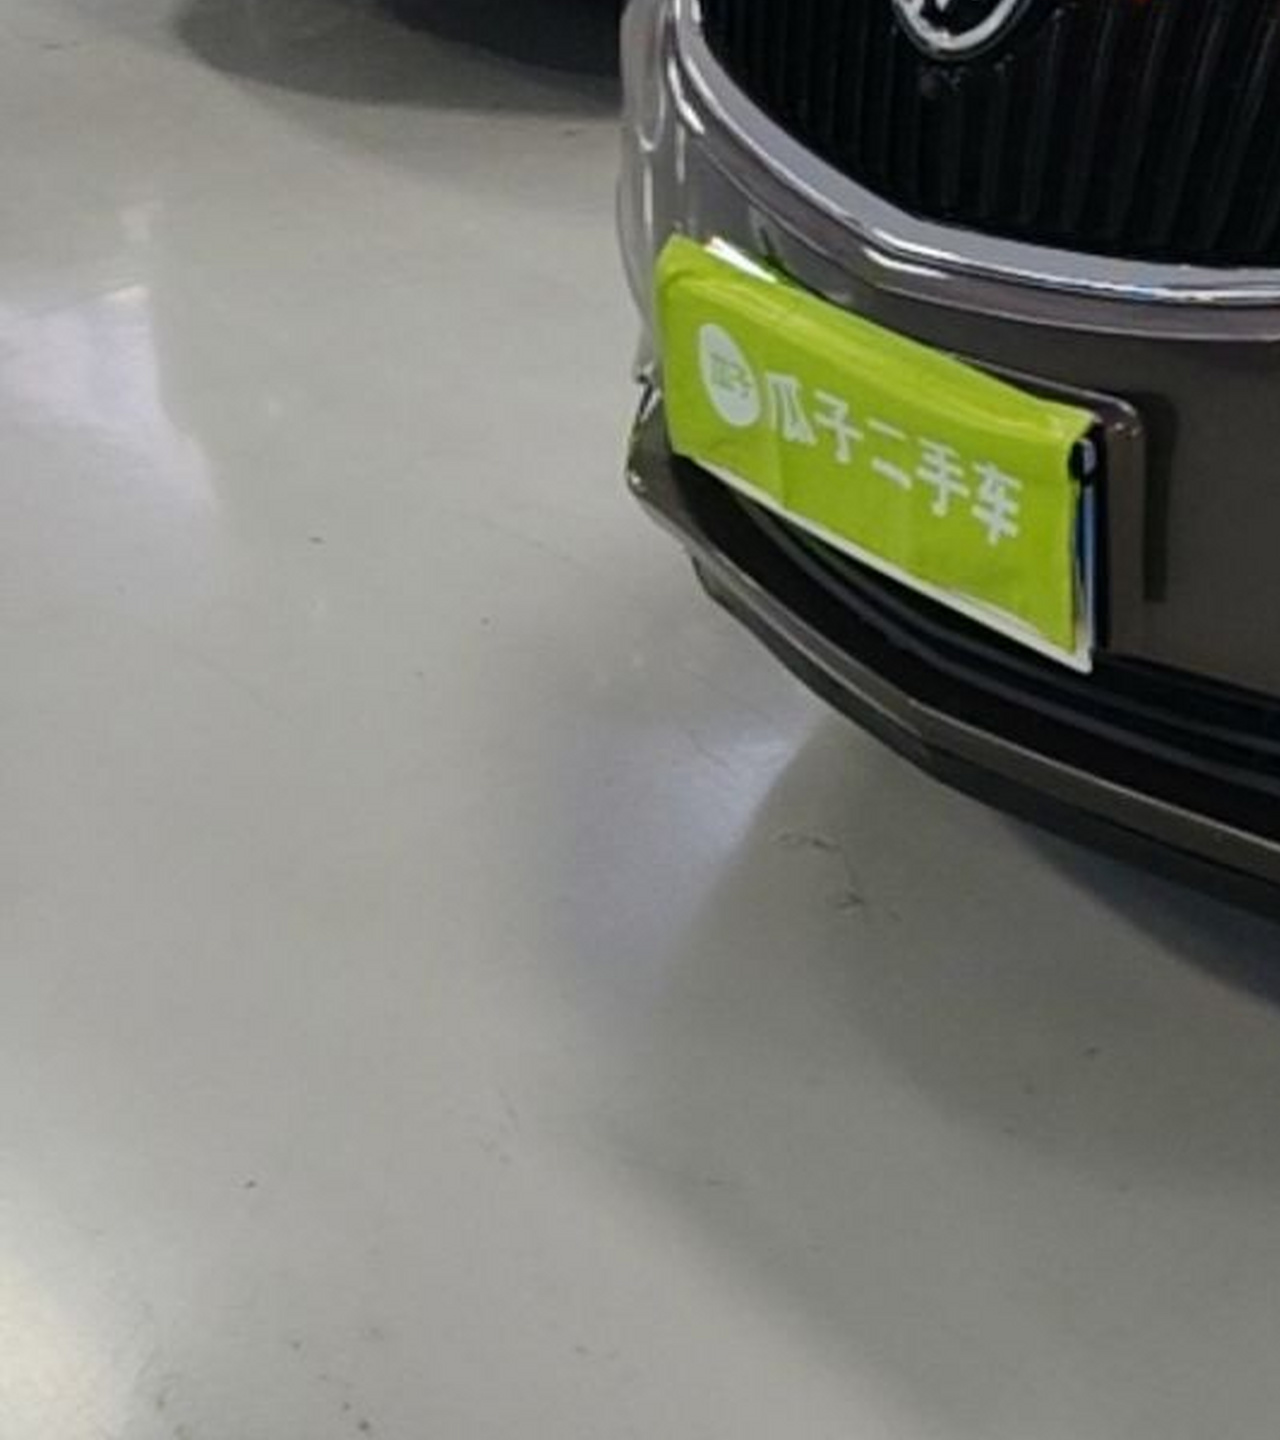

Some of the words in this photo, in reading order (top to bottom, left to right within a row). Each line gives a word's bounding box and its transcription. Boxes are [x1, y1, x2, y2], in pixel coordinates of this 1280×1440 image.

[764, 372, 1024, 545] 瓜子二手车
